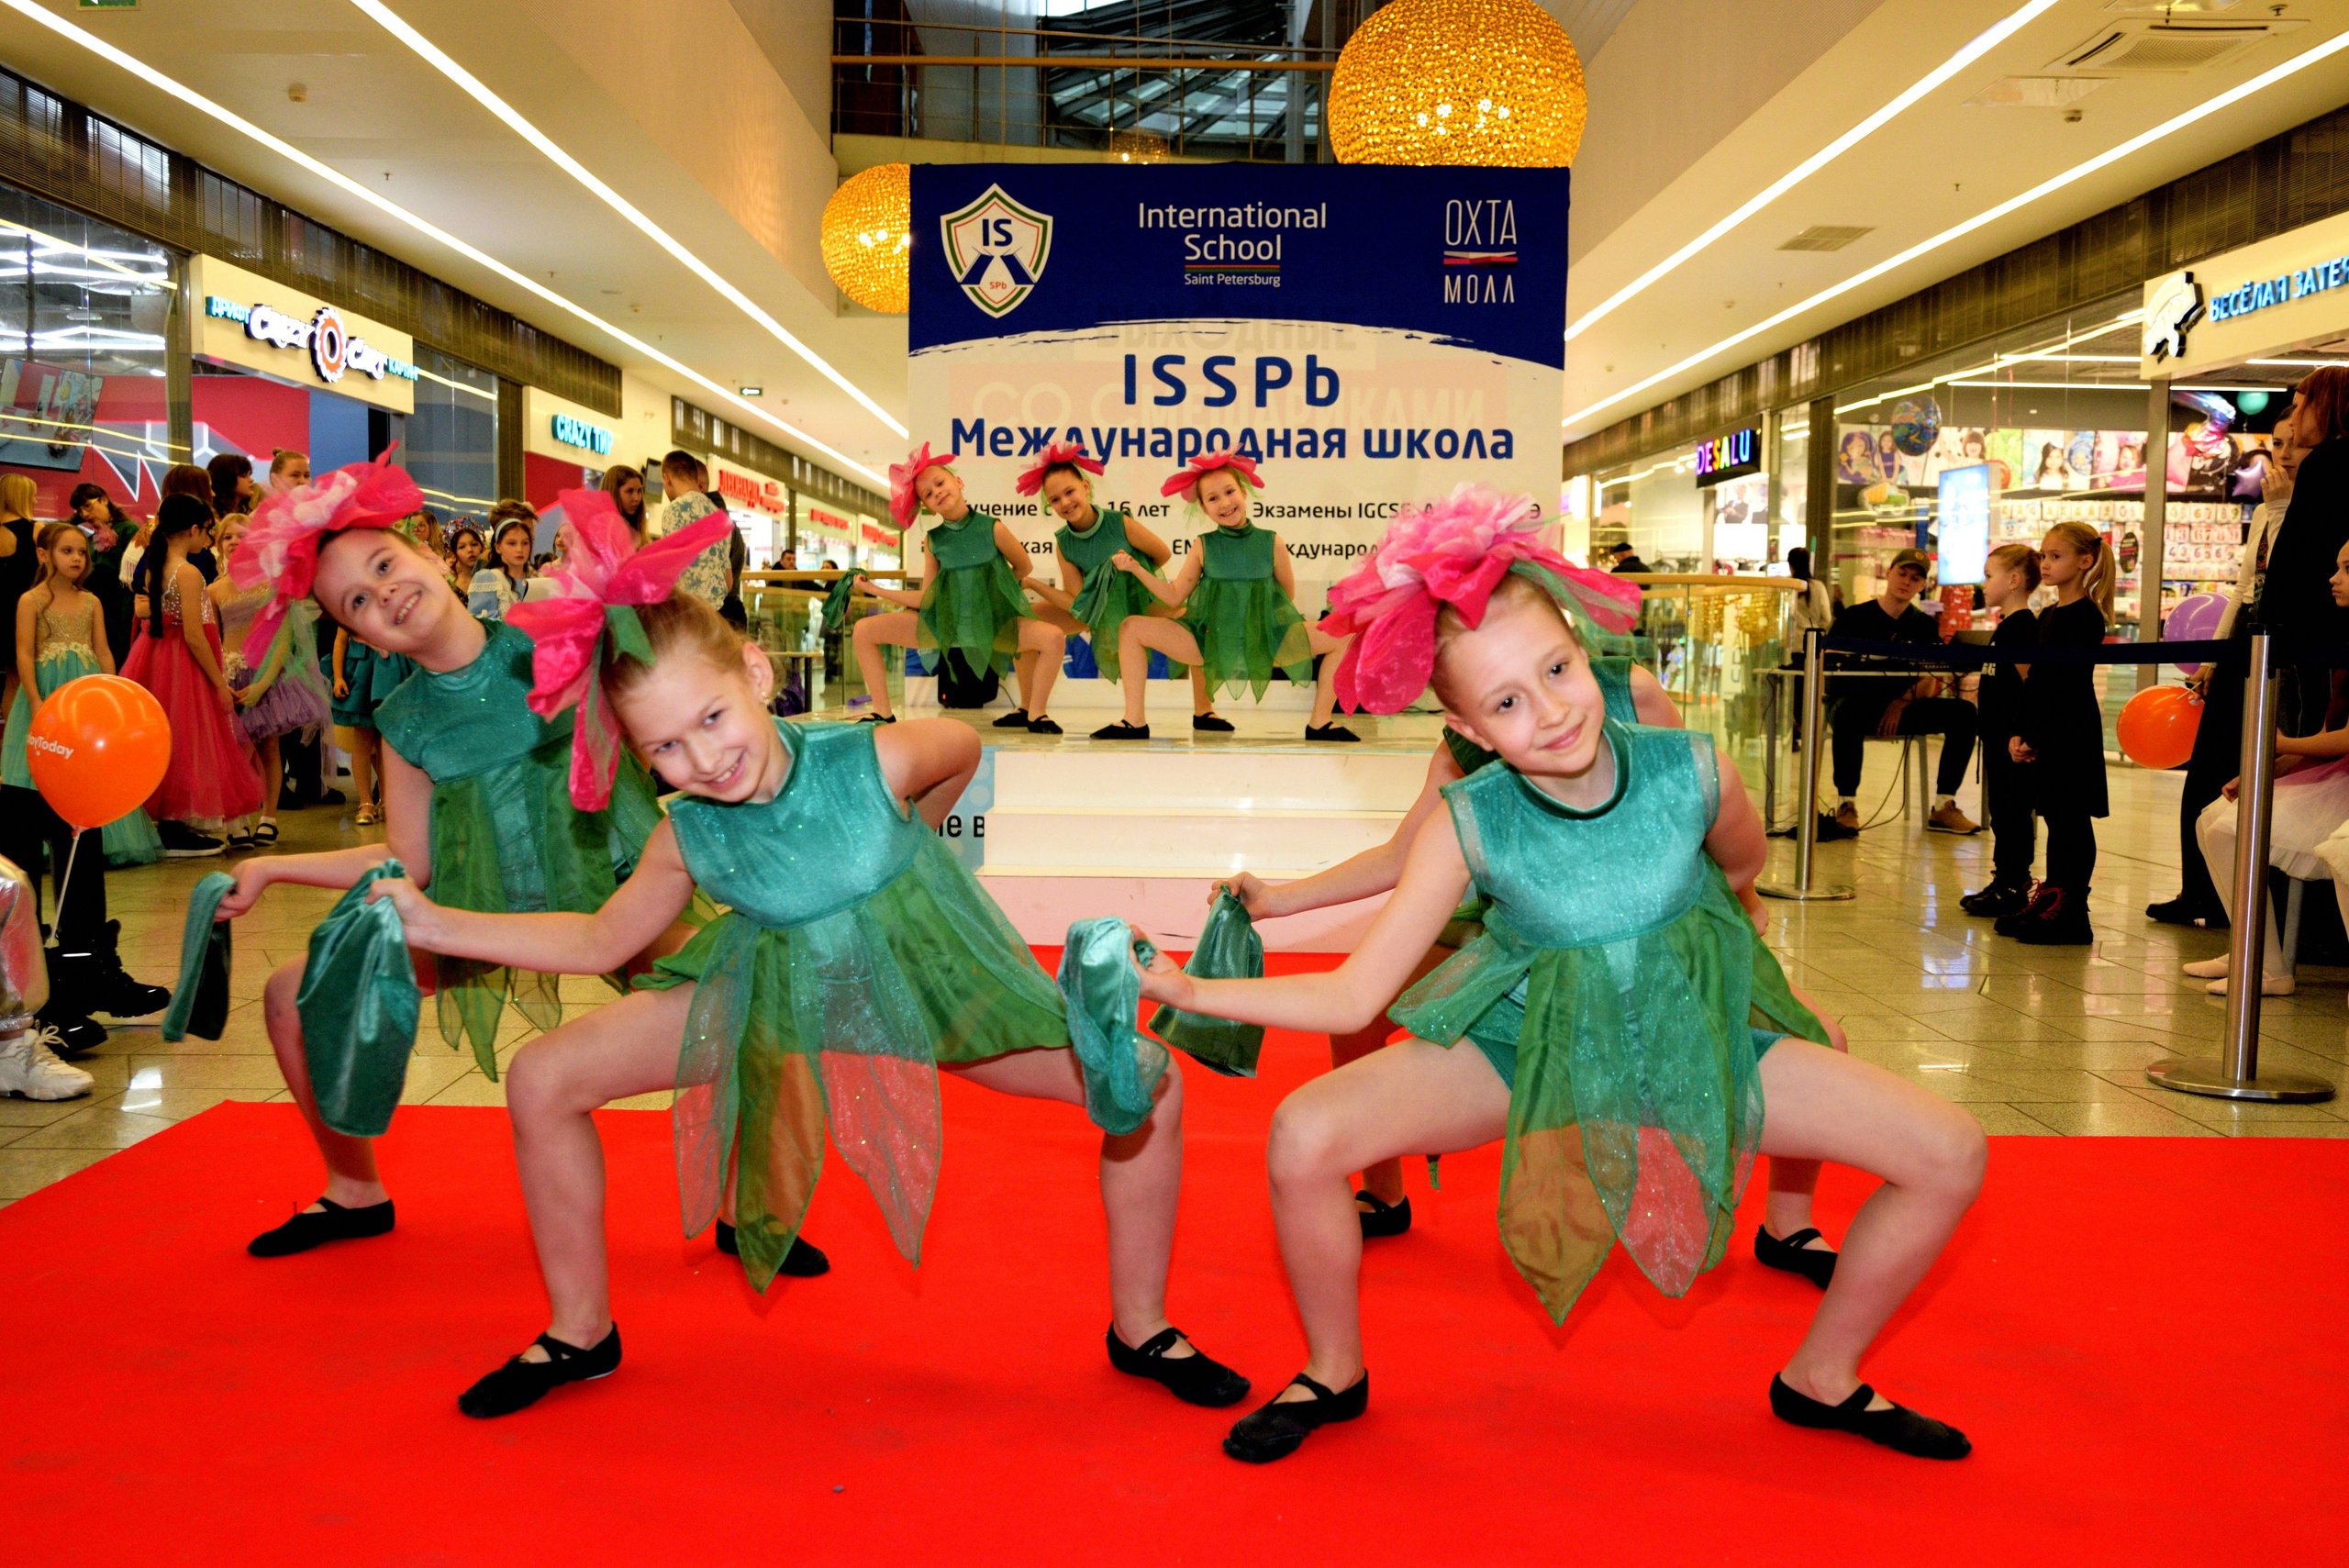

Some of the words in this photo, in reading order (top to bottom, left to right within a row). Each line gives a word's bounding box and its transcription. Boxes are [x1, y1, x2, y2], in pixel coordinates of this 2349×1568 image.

[1139, 201, 1327, 228] International
[1445, 199, 1518, 246] ОХТА
[982, 218, 1013, 247] IS
[1184, 233, 1282, 261] School
[989, 282, 1008, 290] SPb
[1184, 273, 1214, 285] Saint
[1217, 273, 1281, 288] Petersburg
[207, 295, 251, 324] ДРИФТ
[2209, 274, 2290, 322] ВЕСЁЛАЯ
[1124, 354, 1341, 408] ISSPb
[553, 412, 593, 450] CRAZY
[593, 426, 614, 456] ТИР
[952, 417, 1347, 468] Международная
[1364, 427, 1514, 460] школа
[1696, 428, 1751, 476] DESALU
[1138, 505, 1170, 517] лет
[1252, 502, 1353, 518] Экзамены
